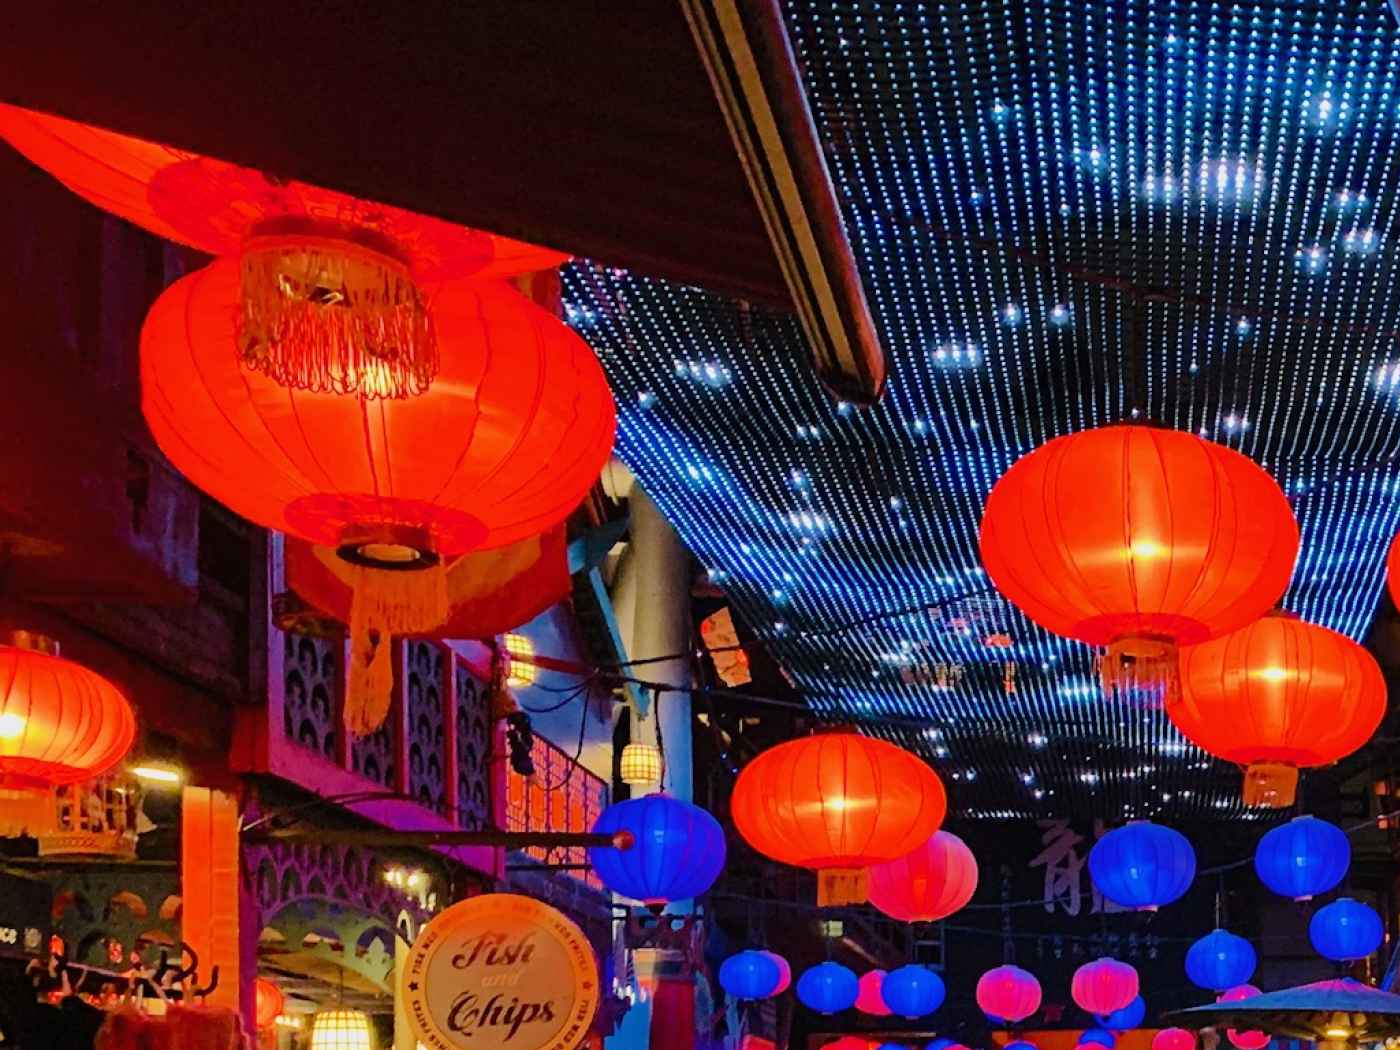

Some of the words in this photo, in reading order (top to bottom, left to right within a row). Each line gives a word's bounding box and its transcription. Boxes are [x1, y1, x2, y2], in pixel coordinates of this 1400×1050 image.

[451, 928, 537, 970] Fish
[480, 968, 524, 988] and
[446, 990, 555, 1042] Chips
